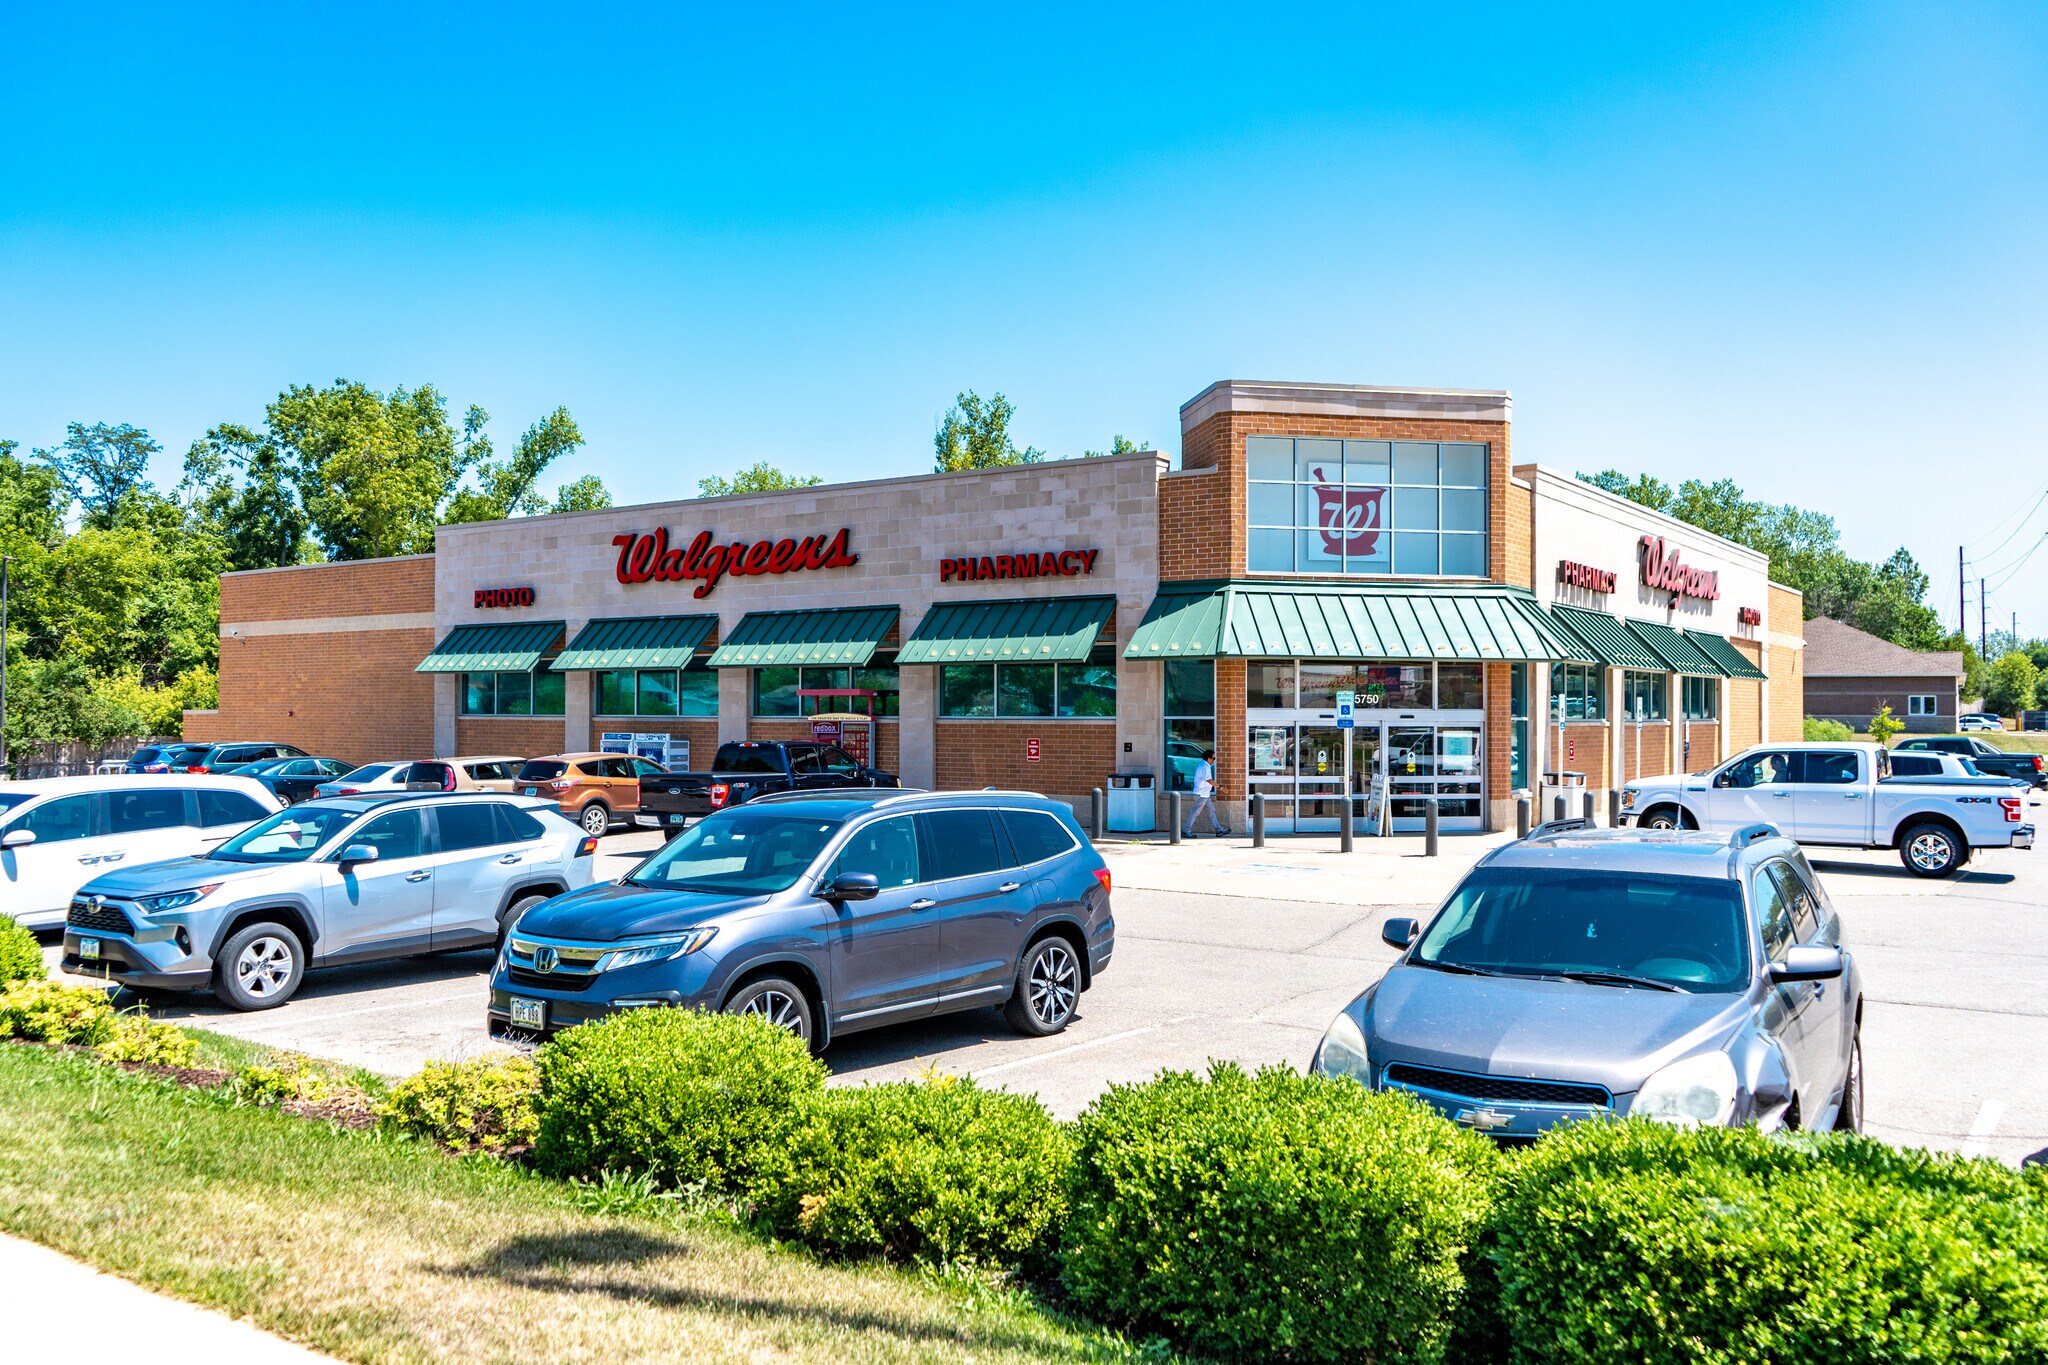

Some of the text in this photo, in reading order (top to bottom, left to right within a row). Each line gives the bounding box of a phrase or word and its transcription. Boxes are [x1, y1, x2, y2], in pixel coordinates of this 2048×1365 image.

[612, 526, 859, 599] Walgreens
[940, 549, 1098, 583] PHARMACY
[1561, 560, 1617, 594] PHARMACY
[1639, 535, 1721, 609] Walgreens
[474, 586, 535, 609] PHOTO
[1742, 607, 1761, 626] PHOTO
[1354, 694, 1379, 704] 5750
